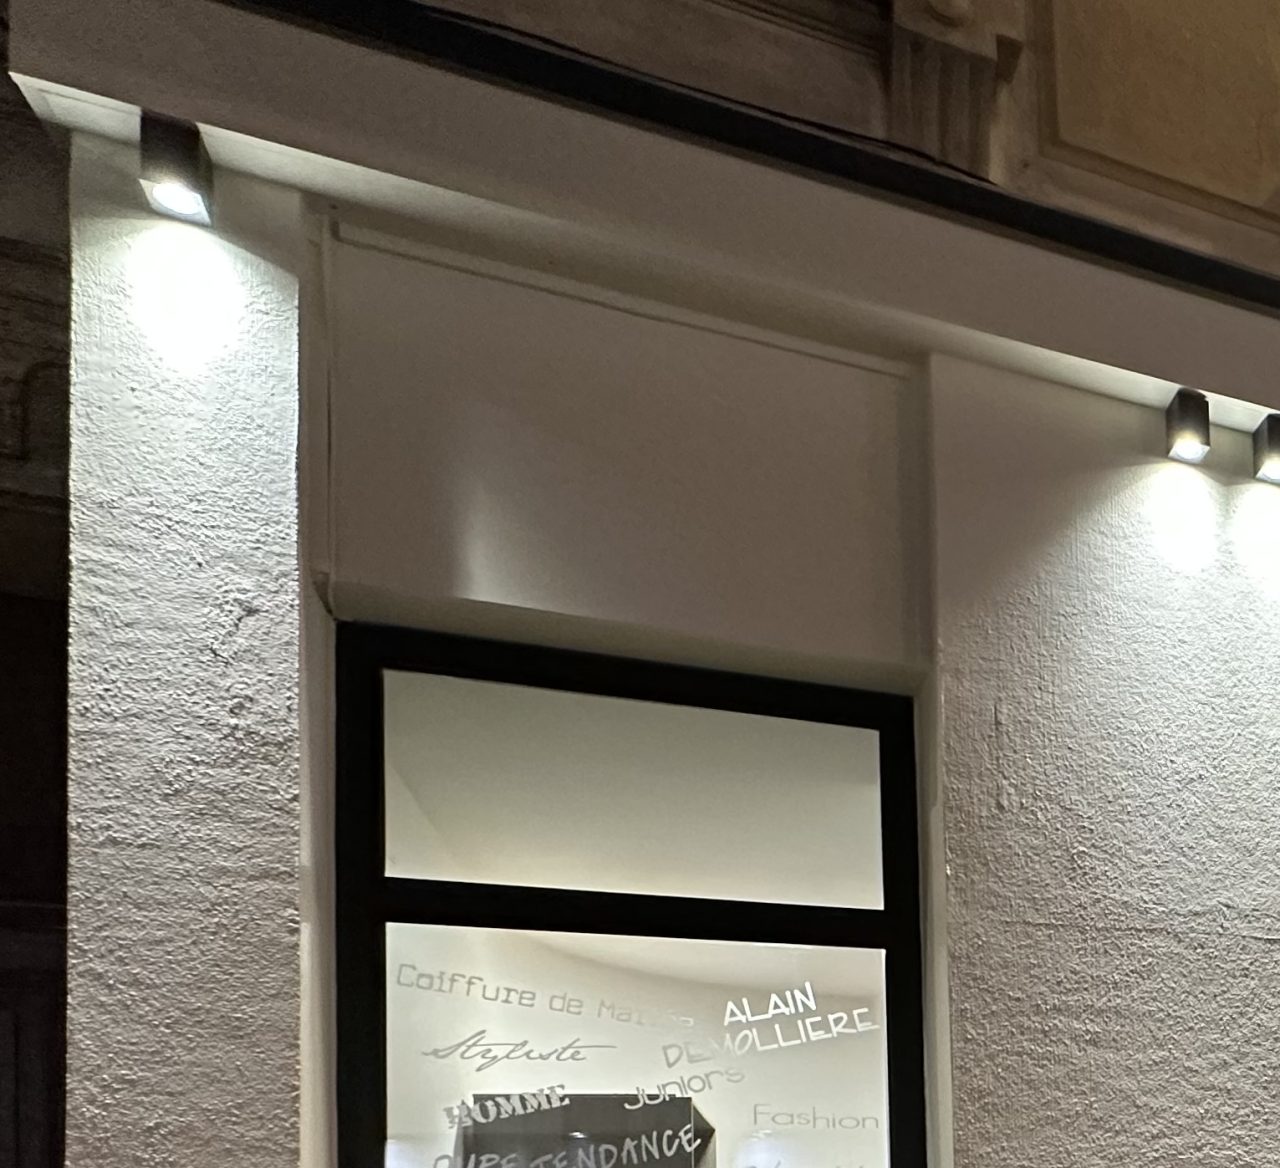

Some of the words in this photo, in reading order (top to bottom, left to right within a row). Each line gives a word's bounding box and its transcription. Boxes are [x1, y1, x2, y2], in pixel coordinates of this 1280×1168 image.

[396, 963, 537, 1008] Coiffure
[548, 992, 584, 1016] de
[723, 980, 817, 1027] ALAIN
[420, 1029, 618, 1073] Styliste
[661, 1007, 881, 1069] DEMOLLIERE
[442, 1083, 571, 1130] HOMME
[622, 1066, 746, 1111] Juniors
[752, 1102, 880, 1130] Fashion
